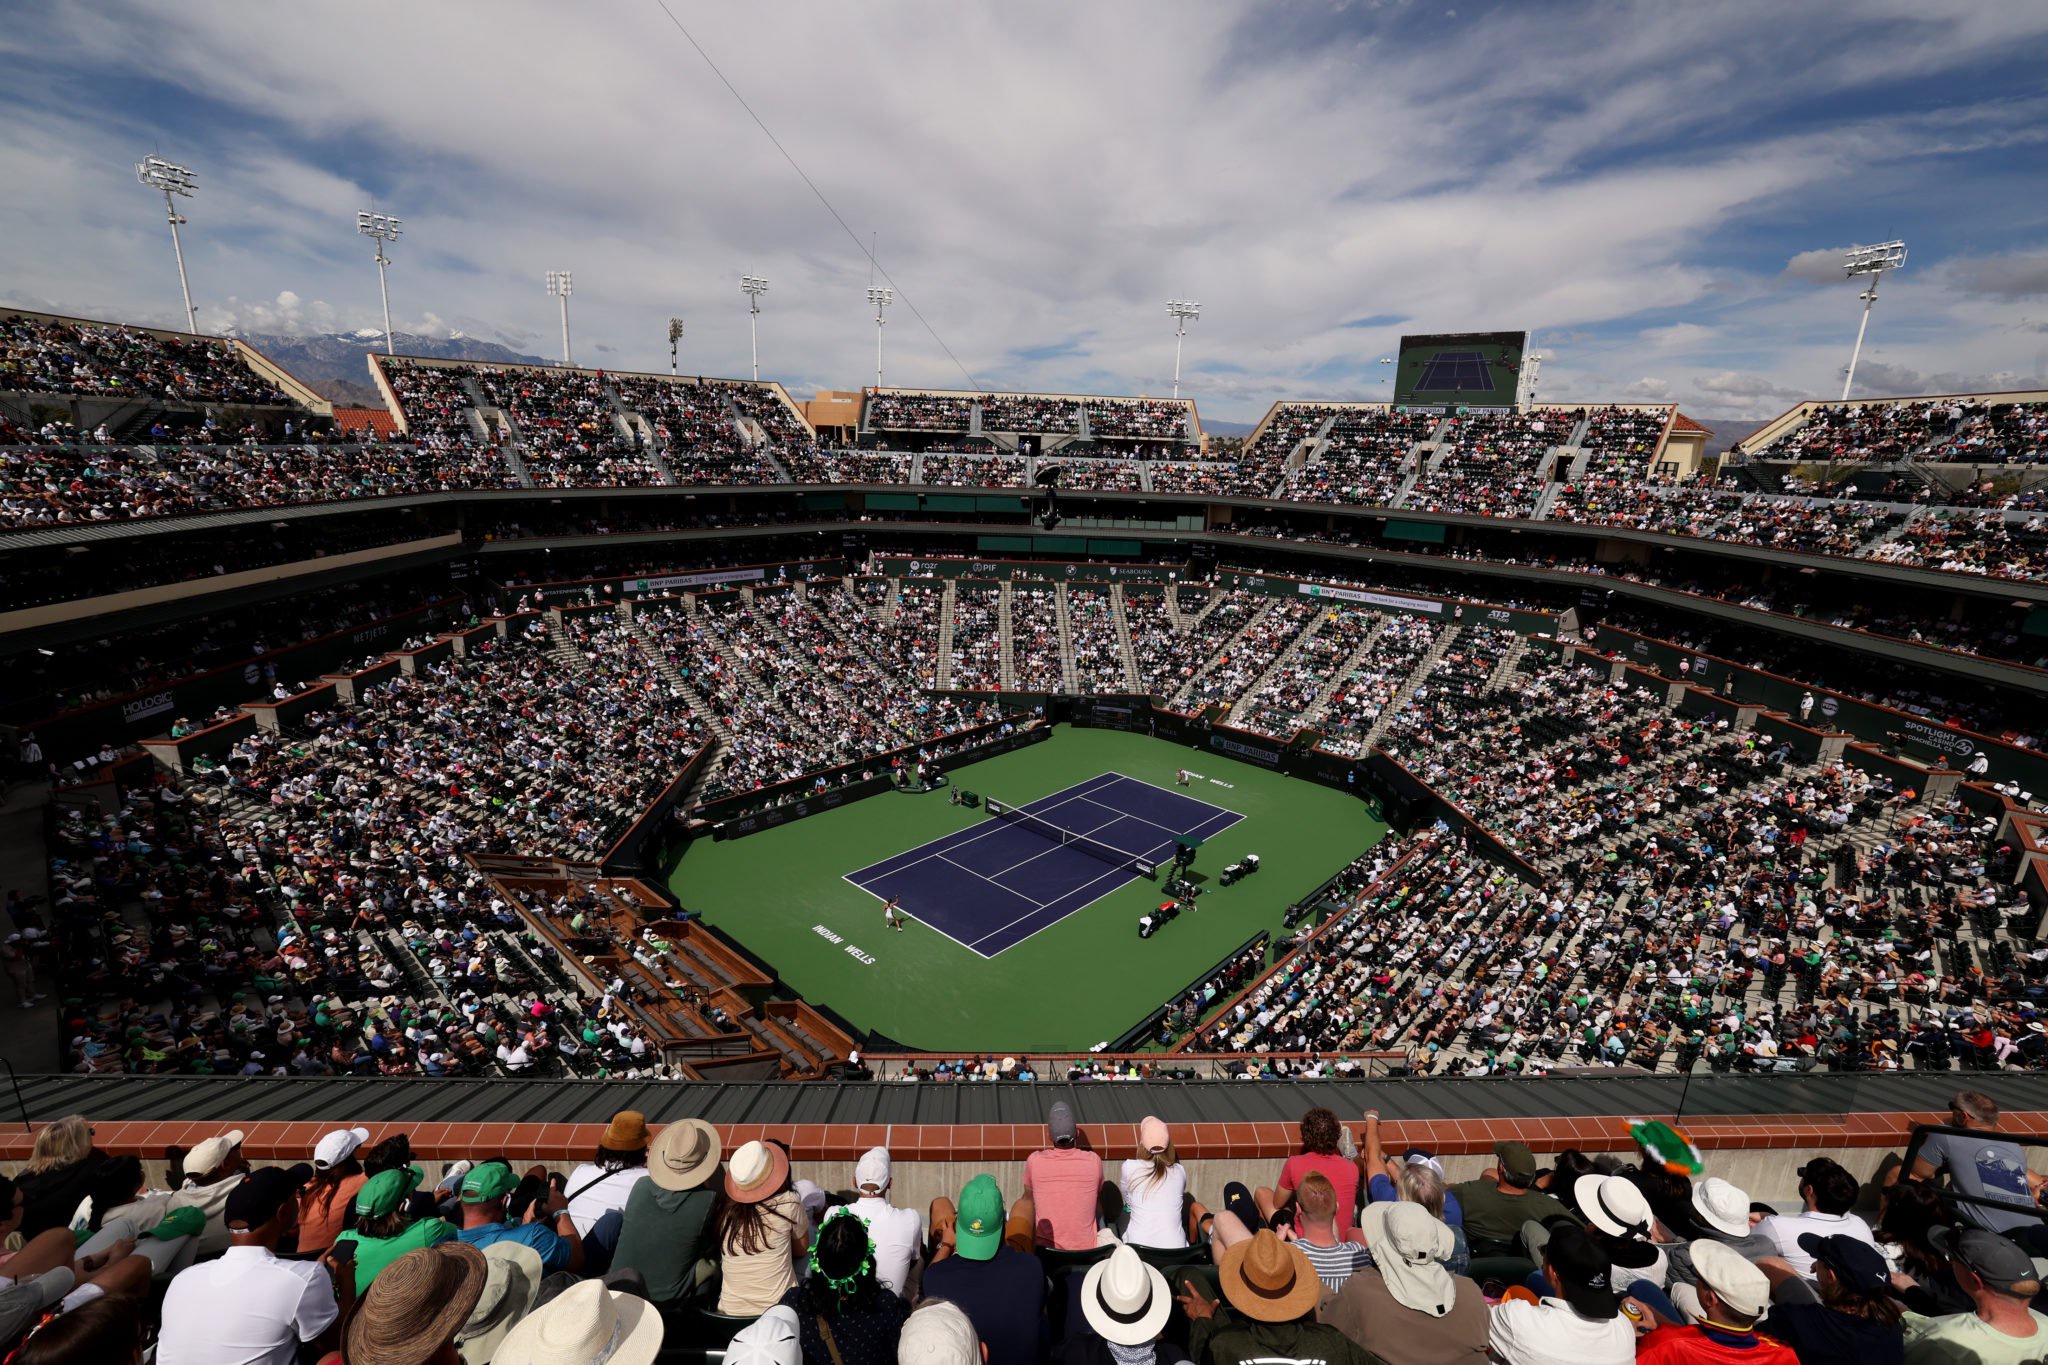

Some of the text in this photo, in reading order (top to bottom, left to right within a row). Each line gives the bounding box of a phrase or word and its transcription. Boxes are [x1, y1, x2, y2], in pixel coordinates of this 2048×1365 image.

[983, 564, 997, 572] PIF
[665, 578, 693, 586] PARIBAS
[1335, 590, 1361, 599] PARIBAS
[1488, 609, 1511, 618] ATP
[353, 625, 389, 643] NETJETS
[122, 690, 174, 716] HOLOGIC
[1904, 721, 1957, 742] SPOTLIGHT
[1928, 735, 1955, 747] CASINO
[1226, 741, 1242, 752] BNP
[1244, 746, 1276, 761] PARIBAS
[811, 924, 876, 965] INDIAN WELLS
